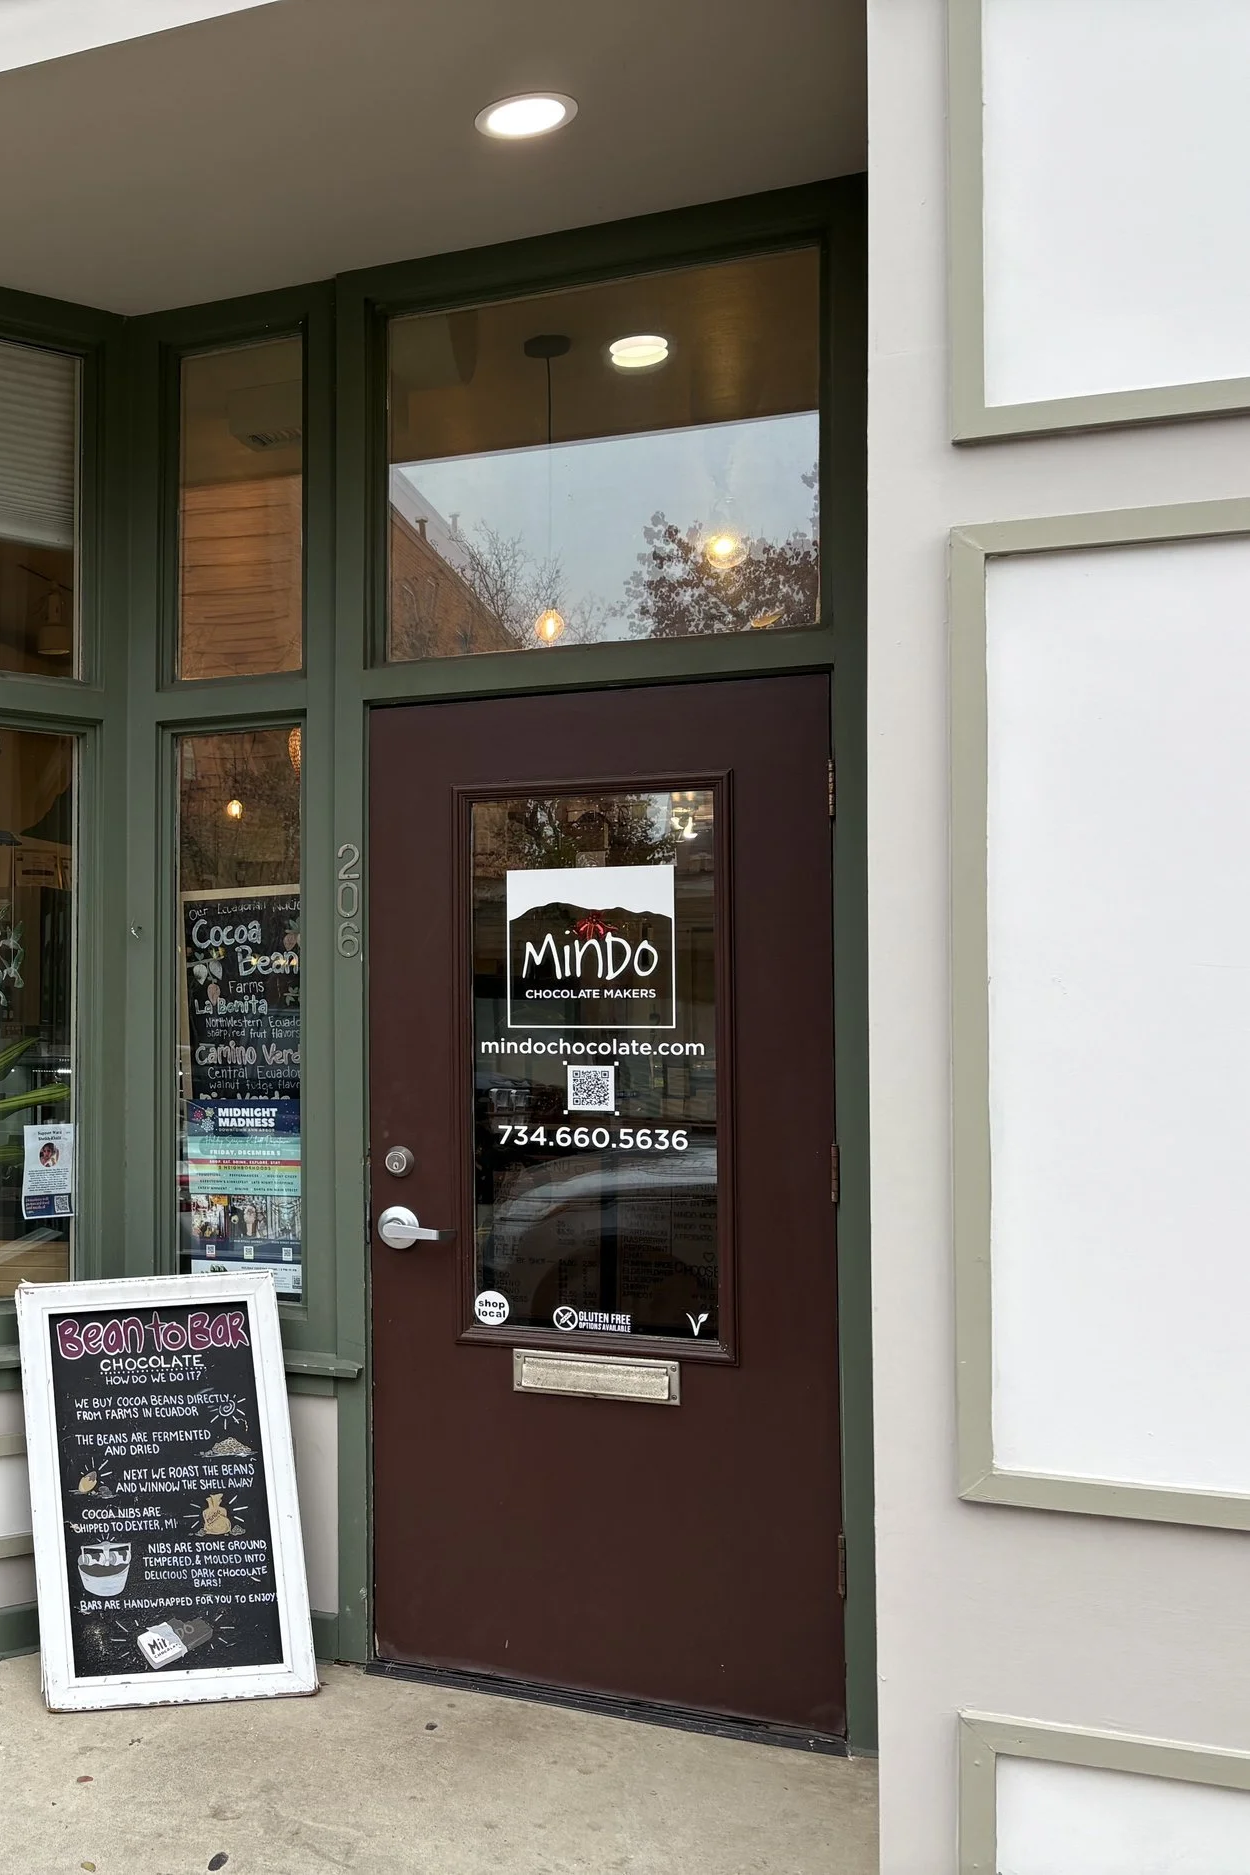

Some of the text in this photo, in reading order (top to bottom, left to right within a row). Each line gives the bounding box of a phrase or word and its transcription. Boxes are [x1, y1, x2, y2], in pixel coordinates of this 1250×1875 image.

[337, 843, 360, 958] 206
[191, 919, 262, 949] Cocoa
[228, 980, 265, 994] Farms
[525, 988, 657, 999] CHOCOLATE MAKERS
[194, 995, 268, 1015] La Bonita
[231, 1028, 246, 1037] red
[250, 1028, 267, 1039] fruit
[195, 1040, 257, 1066] Camino
[481, 1038, 705, 1056] mindochocolate.com
[207, 1066, 248, 1080] Central
[209, 1079, 240, 1090] walnut
[218, 1107, 278, 1118] MIDNIGHT
[218, 1118, 275, 1128] MADNESS
[498, 1125, 689, 1151] 734.660.5636
[478, 1299, 506, 1310] shop
[478, 1308, 506, 1318] local
[578, 1310, 632, 1325] GLUTEN FREE
[578, 1321, 631, 1333] OPTIONS AVAILABLE
[100, 1354, 205, 1372] CHOCOLATE
[105, 1370, 202, 1386] HOW DO WE DO IT?
[74, 1398, 89, 1409] WE
[92, 1397, 113, 1408] BUY
[116, 1396, 149, 1407] COCOA
[150, 1395, 184, 1406] BEANS
[76, 1406, 199, 1421] FROM FARMS IN ECUADOR
[75, 1429, 211, 1446] THE BEANS ARE FERMENTED
[104, 1444, 160, 1456] AND DRIED
[123, 1463, 255, 1481] NEXT WE ROAST THE BEANS
[115, 1477, 254, 1493] AND WINNOW THE SHELL AWAY
[81, 1506, 162, 1520] COCOA NIBS ARE
[74, 1518, 178, 1534] SHIPPED TO DEXTER, MI
[147, 1540, 268, 1554] NIBS ARE STONE GROUND,
[204, 1554, 242, 1565] MOLDED
[244, 1553, 266, 1563] INTO
[144, 1565, 268, 1581] DELICIOUS DARK CHOCOLATE
[194, 1578, 222, 1588] BARS!
[80, 1599, 103, 1611] BARS
[104, 1599, 121, 1611] ARE
[123, 1596, 193, 1610] HANDWRAPPED
[195, 1595, 213, 1606] FOR
[213, 1594, 232, 1605] YOU
[234, 1593, 247, 1604] TO
